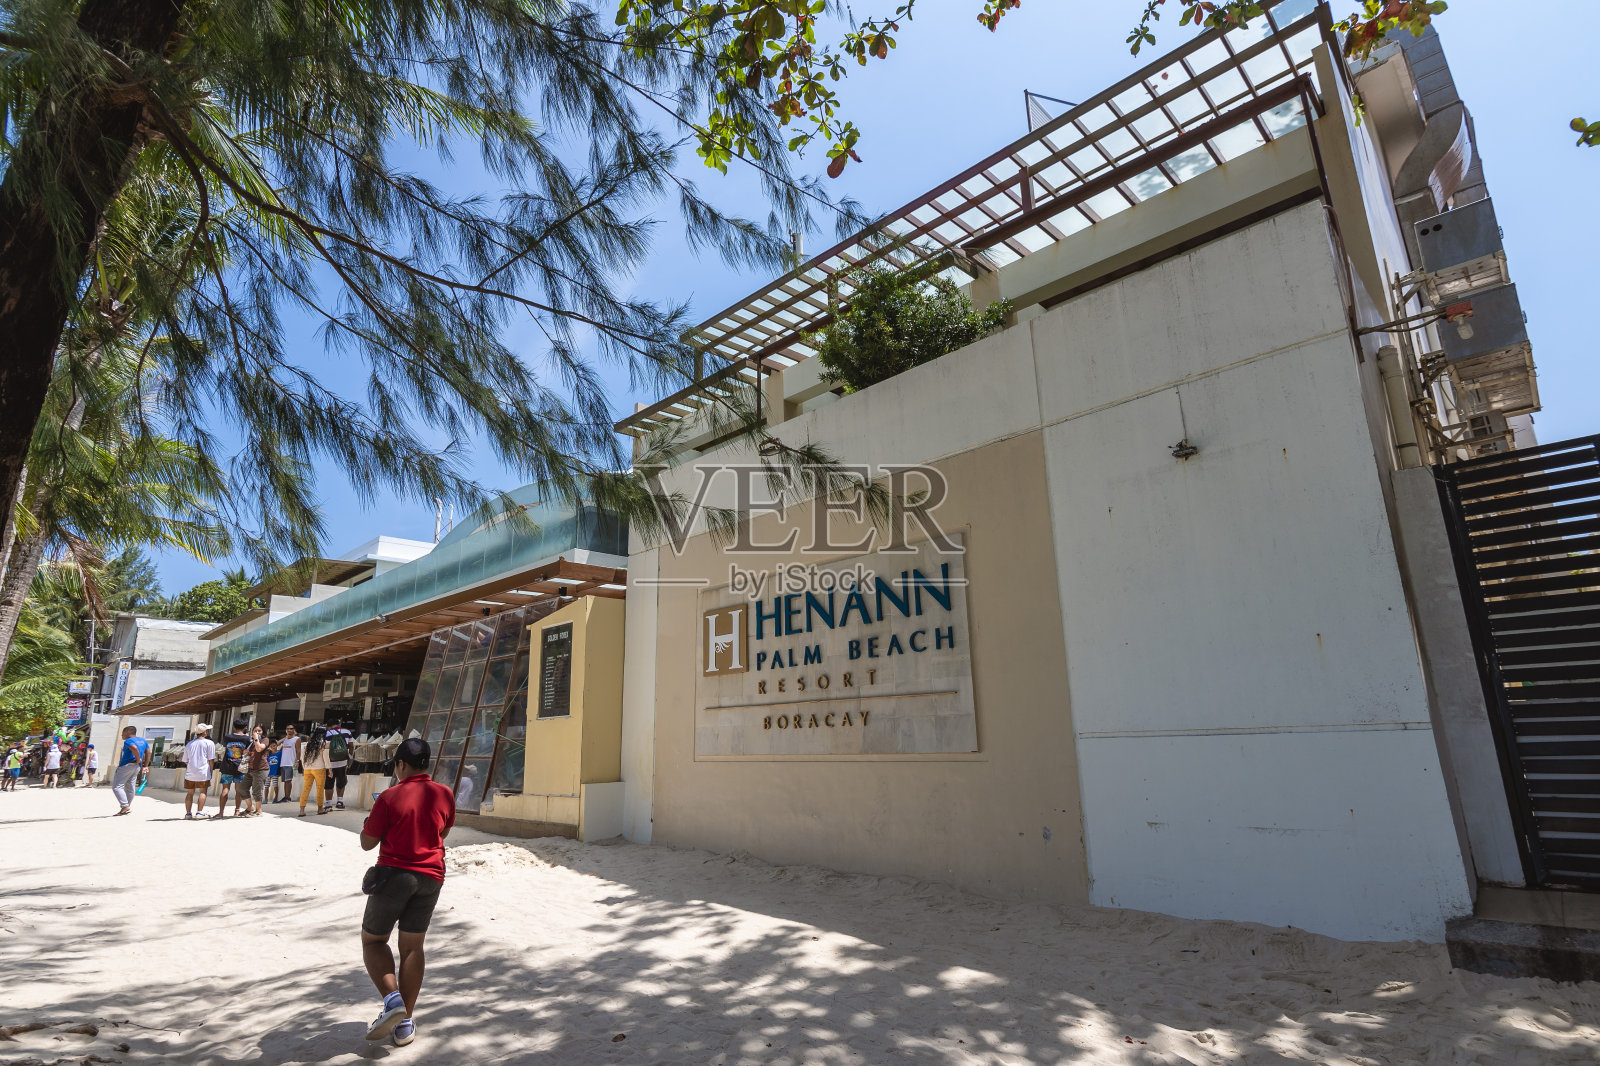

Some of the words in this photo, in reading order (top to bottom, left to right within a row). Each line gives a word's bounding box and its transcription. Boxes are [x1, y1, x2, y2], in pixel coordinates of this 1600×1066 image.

[755, 562, 952, 641] HENANN
[756, 644, 822, 671] PALM
[848, 626, 955, 661] BEACH
[758, 669, 877, 695] RESORT
[763, 711, 871, 731] BORACAY
